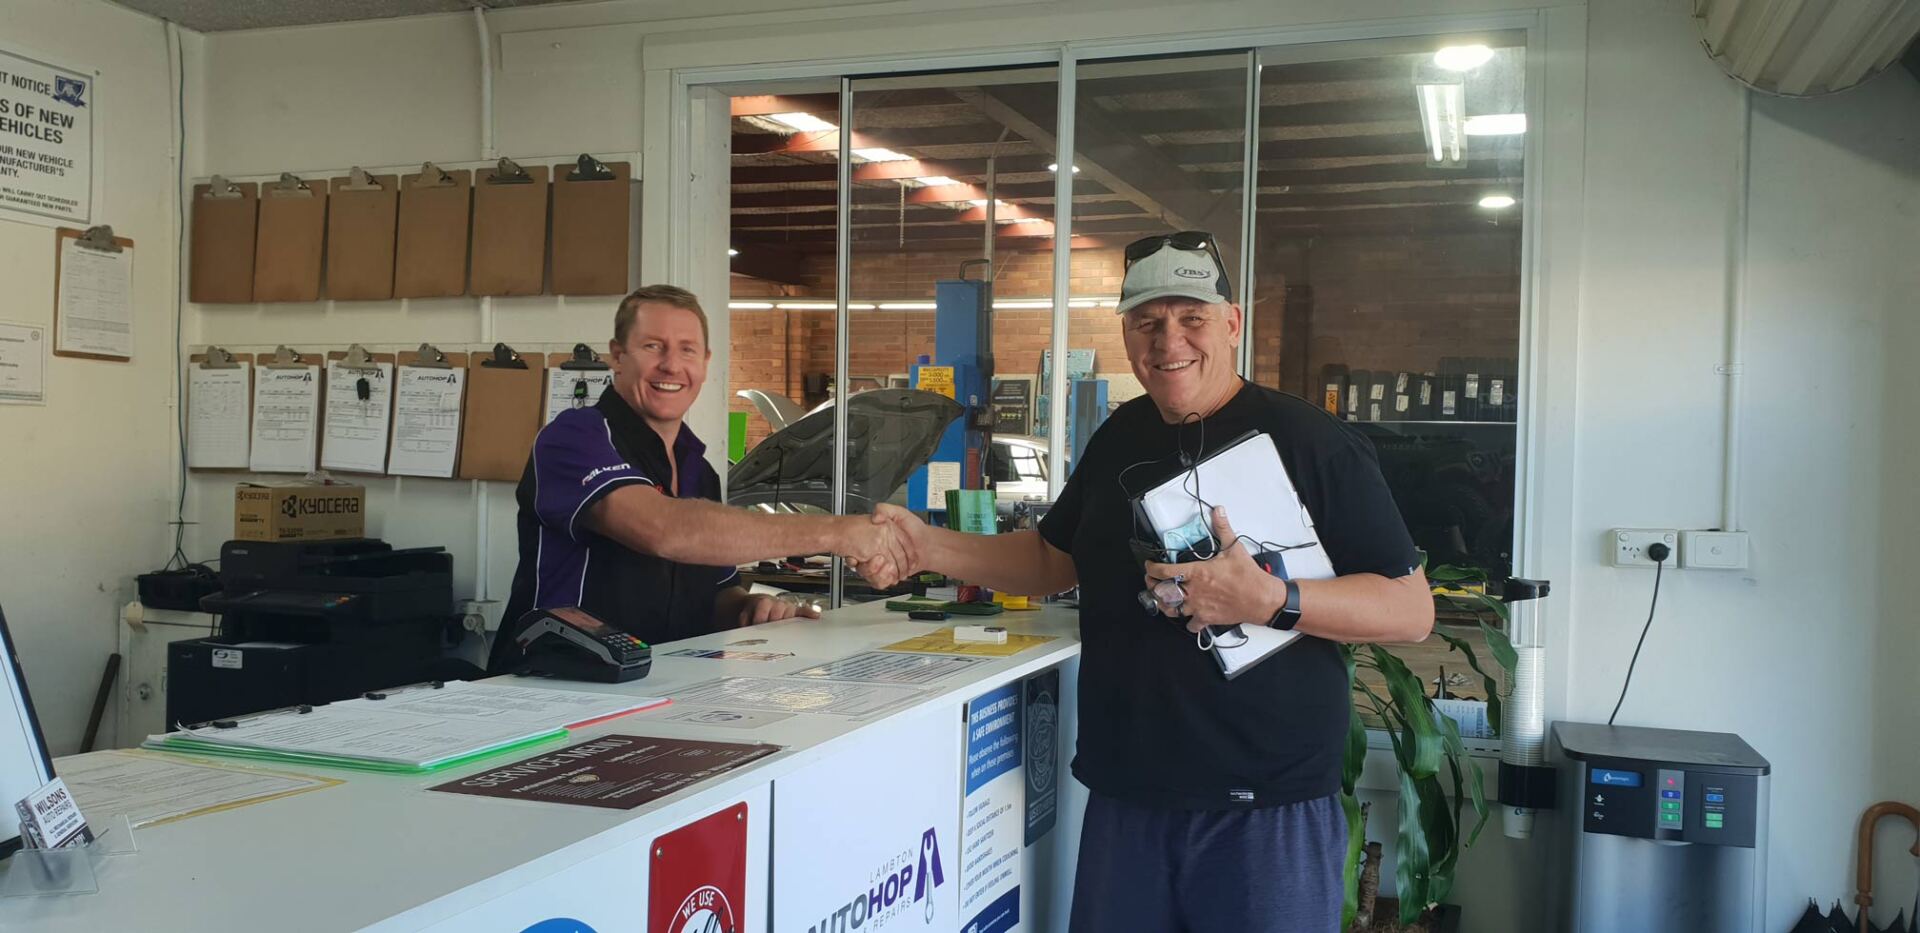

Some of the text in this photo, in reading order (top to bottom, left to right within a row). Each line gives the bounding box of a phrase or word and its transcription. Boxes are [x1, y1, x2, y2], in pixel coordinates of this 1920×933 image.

[12, 75, 51, 96] NOTICE
[14, 103, 34, 118] OF
[39, 108, 74, 129] NEW
[16, 148, 36, 160] NEW
[38, 153, 74, 168] VEHICLE
[0, 166, 20, 178] NTY.
[1183, 268, 1204, 276] JBS
[582, 463, 632, 486] FALKEN
[299, 497, 359, 515] KYOCERA
[979, 702, 997, 721] BUSINESS
[976, 725, 985, 740] SAFE
[985, 711, 1014, 735] ENVIRONMENT
[461, 753, 575, 788] SERVICE
[570, 738, 633, 759] MENU
[34, 787, 67, 816] WILSONS
[42, 800, 73, 824] AUTO REPAIRS
[869, 848, 914, 884] LAMBTON
[682, 891, 716, 920] WE USE
[807, 864, 913, 933] UTOHOP
[873, 896, 911, 932] REPAIRS
